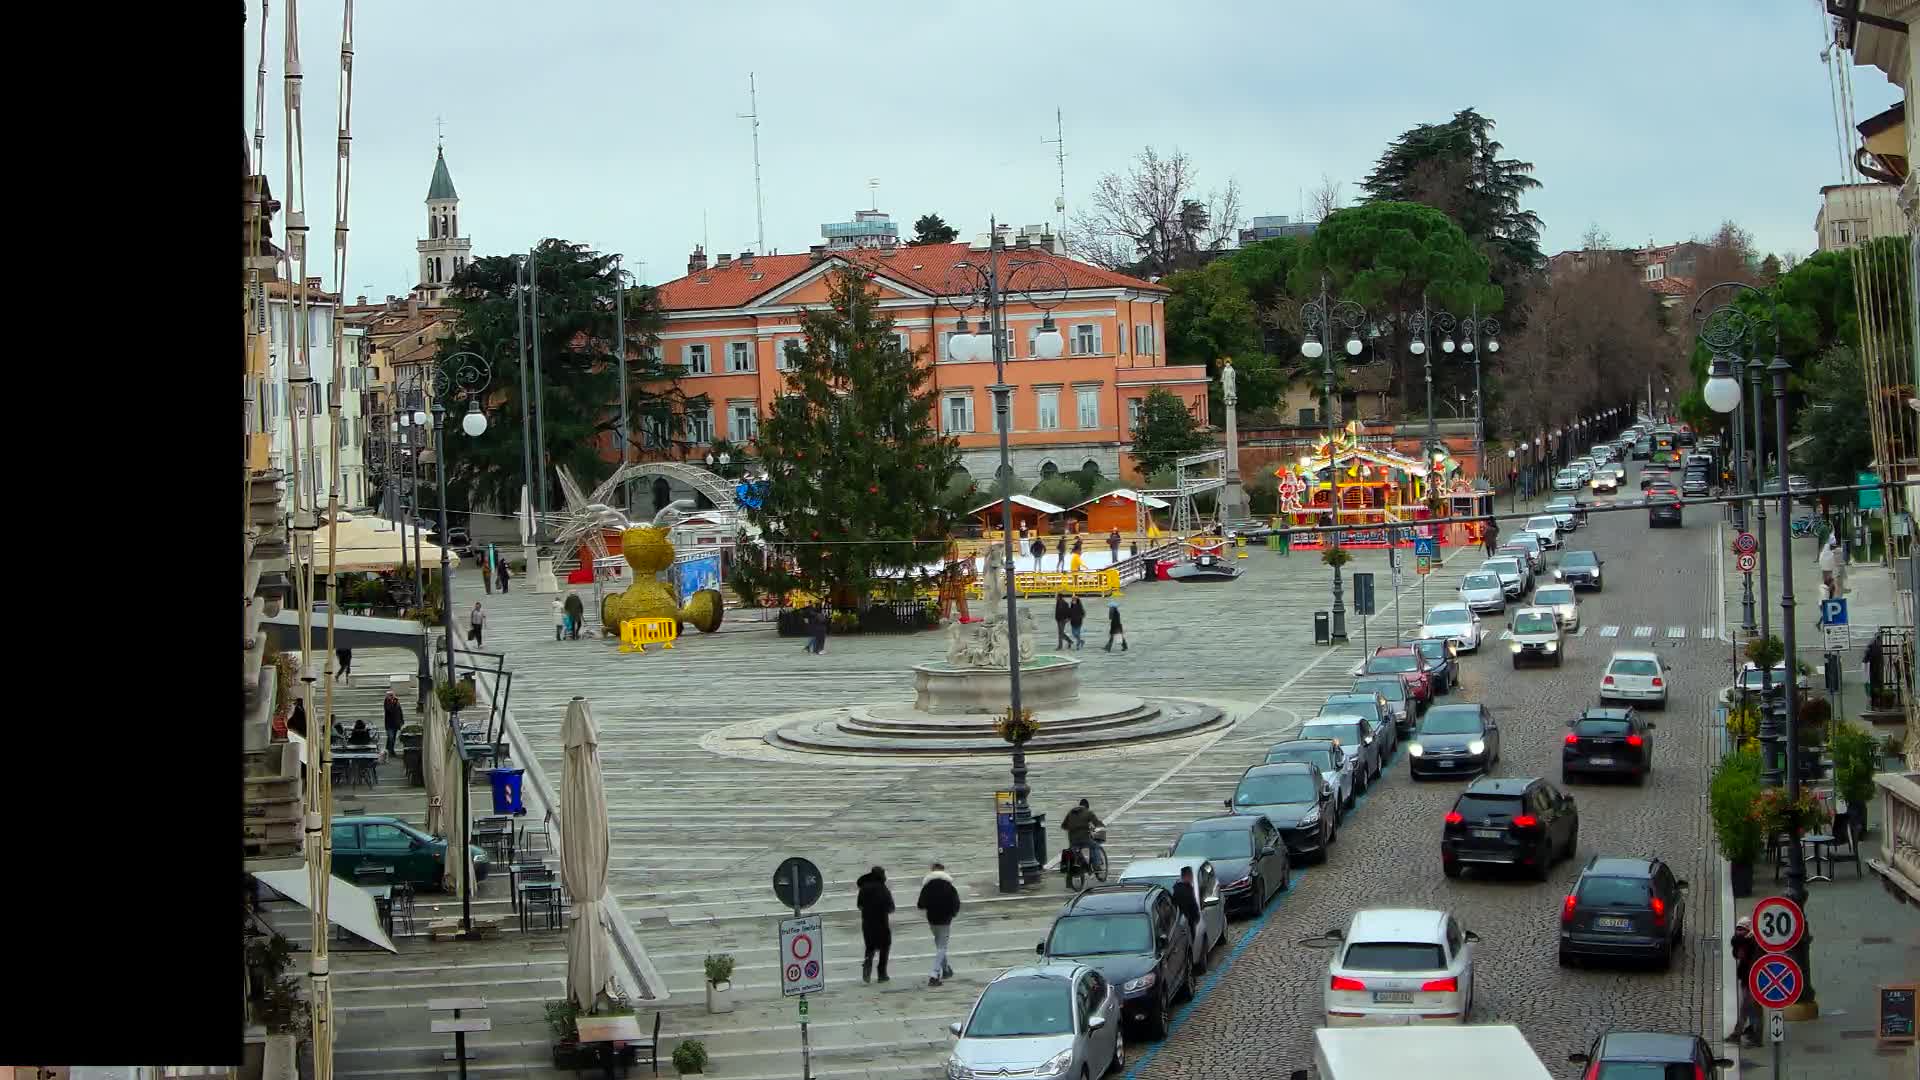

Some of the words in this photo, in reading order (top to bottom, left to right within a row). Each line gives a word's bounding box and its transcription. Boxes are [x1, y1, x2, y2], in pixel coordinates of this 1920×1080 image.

[1742, 557, 1752, 566] 20
[1827, 602, 1842, 622] P
[1762, 911, 1792, 937] 30
